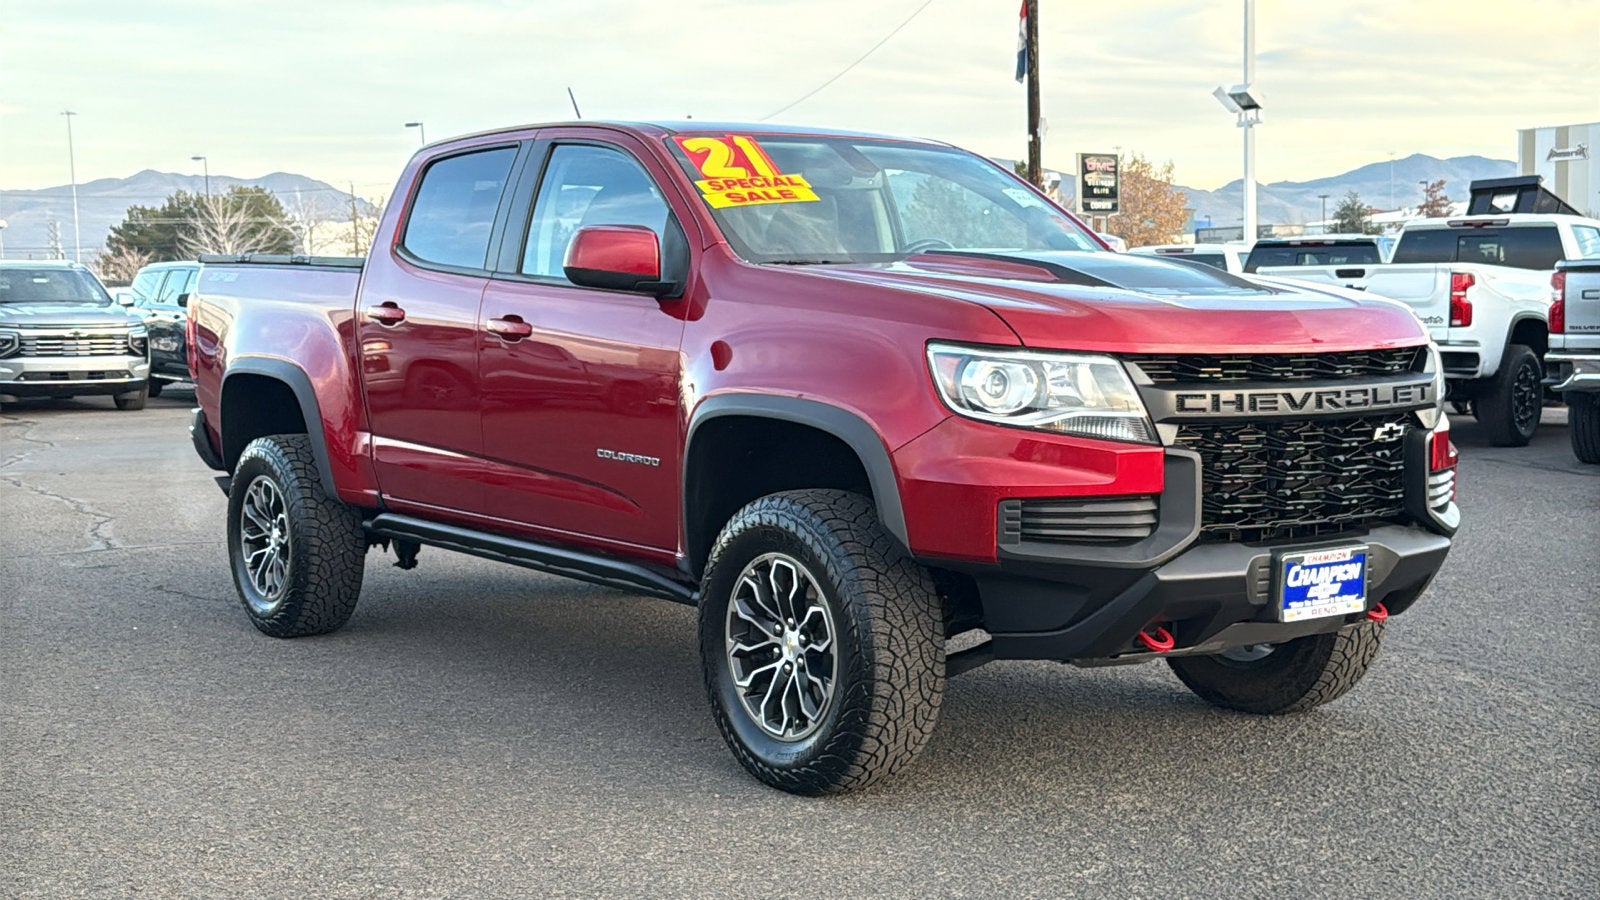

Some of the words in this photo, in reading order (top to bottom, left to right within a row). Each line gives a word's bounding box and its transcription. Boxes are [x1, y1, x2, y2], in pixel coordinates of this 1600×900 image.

[682, 136, 776, 178] 21
[707, 176, 801, 191] SPECIAL
[725, 189, 797, 203] SALE
[1175, 382, 1432, 413] CHEVROLET
[596, 448, 660, 466] COLORADO
[1307, 551, 1348, 563] CHAMPION
[1287, 562, 1362, 588] CHAMPION
[1311, 606, 1338, 616] RENO
